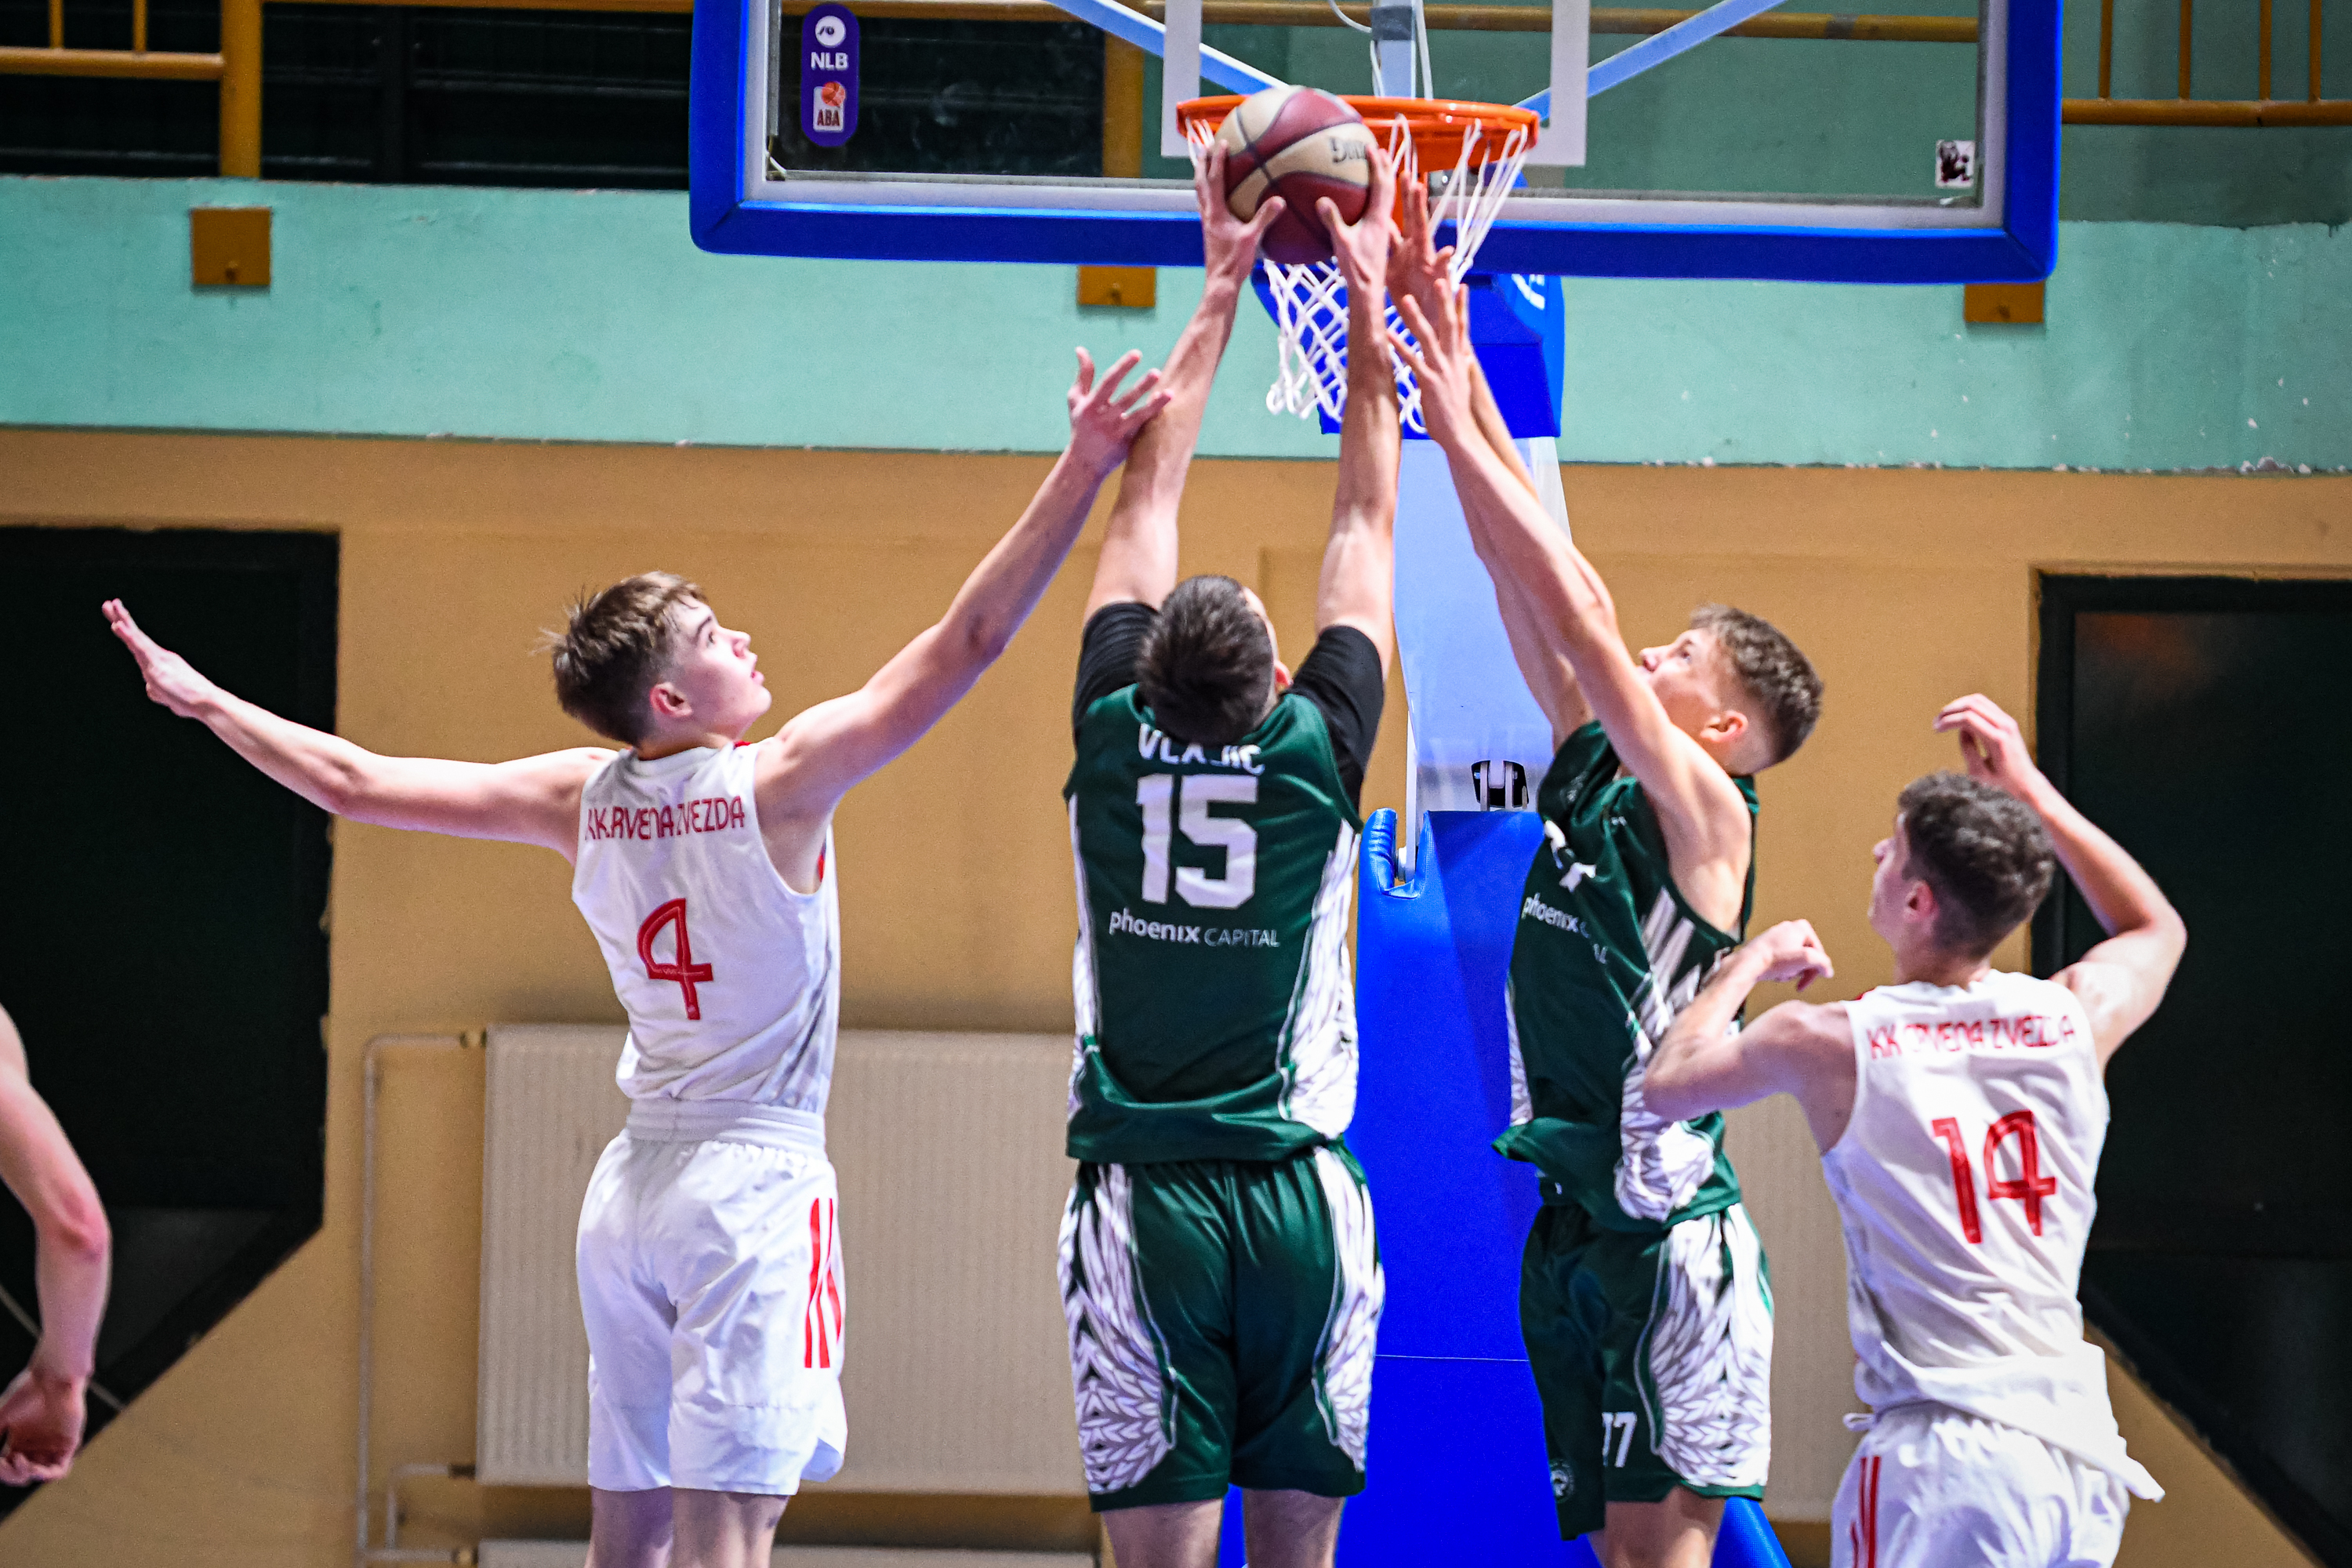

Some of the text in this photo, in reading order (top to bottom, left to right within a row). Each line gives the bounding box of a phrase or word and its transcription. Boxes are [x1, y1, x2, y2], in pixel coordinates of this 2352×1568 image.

[811, 52, 849, 71] NLB
[817, 109, 840, 127] ABA
[607, 805, 674, 840] RVENA
[1136, 772, 1259, 910] 15
[1109, 906, 1281, 948] phoenix CAPITAL
[637, 897, 714, 1021] 4
[1867, 1023, 1903, 1060] KK
[1931, 1109, 2058, 1245] 14
